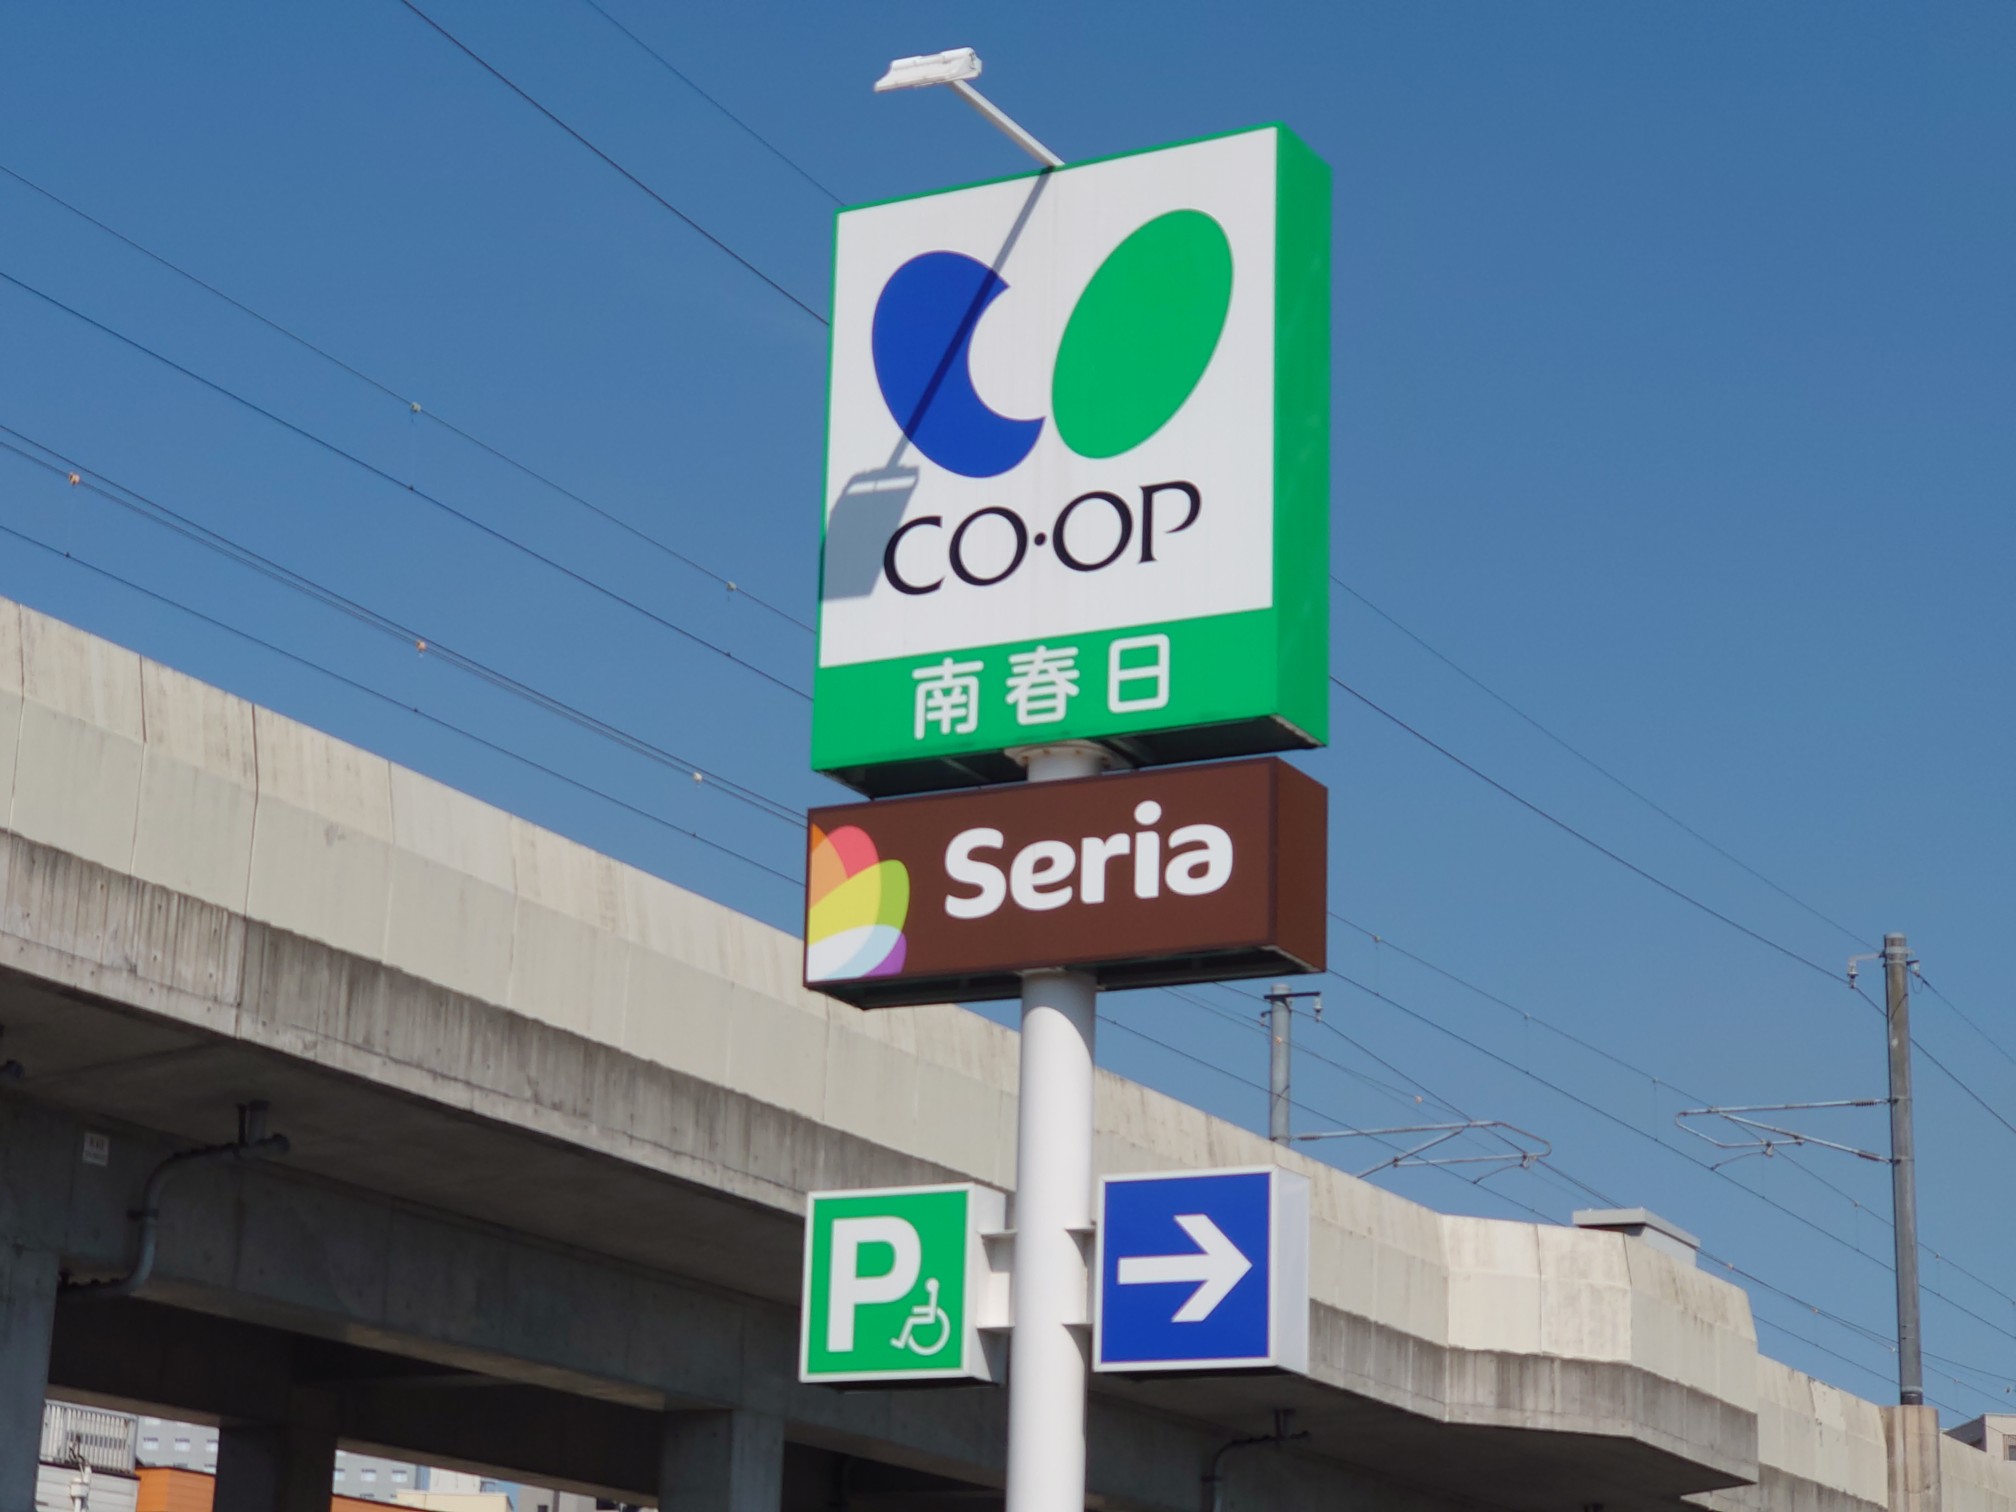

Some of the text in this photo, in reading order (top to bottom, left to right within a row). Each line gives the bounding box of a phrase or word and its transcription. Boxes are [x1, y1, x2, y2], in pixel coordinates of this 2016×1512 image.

[911, 633, 1171, 742] 南春日
[944, 799, 1234, 920] Seria
[827, 1215, 922, 1352] P
